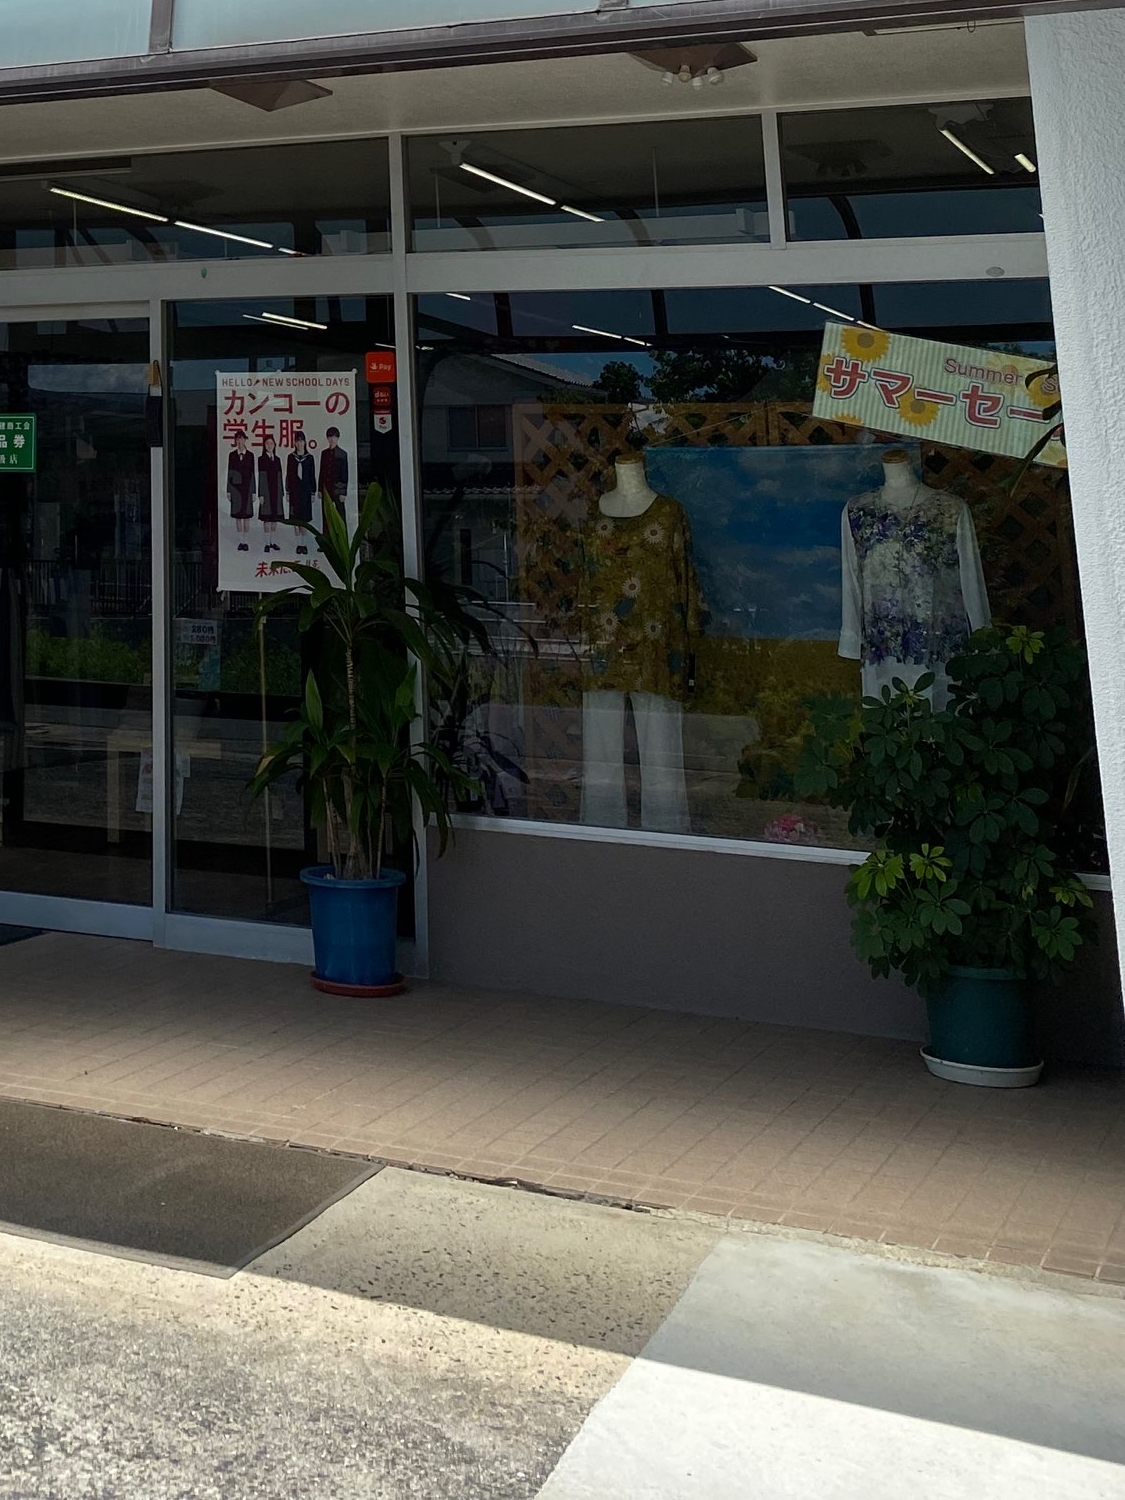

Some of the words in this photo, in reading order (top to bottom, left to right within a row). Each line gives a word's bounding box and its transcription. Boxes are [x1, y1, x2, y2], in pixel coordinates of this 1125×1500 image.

[262, 378, 284, 387] NEW
[286, 378, 323, 387] SCHOOL
[325, 377, 350, 387] DAYS
[943, 357, 1024, 388] Summer
[223, 389, 350, 416] カンコーの
[824, 356, 1065, 440] サマーセー
